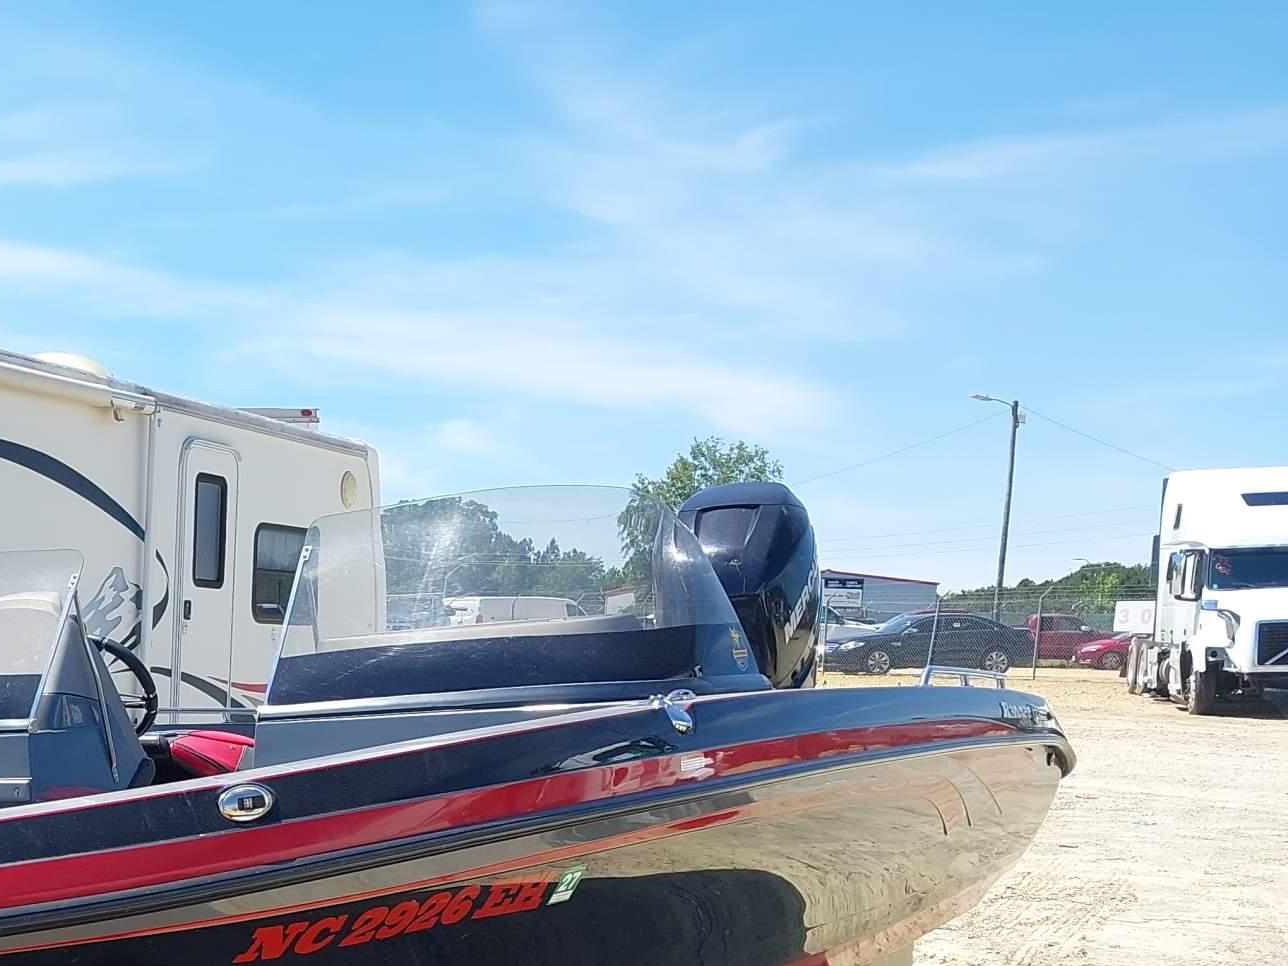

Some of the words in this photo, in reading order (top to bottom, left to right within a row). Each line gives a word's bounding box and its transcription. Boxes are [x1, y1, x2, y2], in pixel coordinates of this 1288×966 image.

[557, 871, 582, 892] 27
[231, 914, 349, 964] NC
[338, 882, 482, 948] 2926
[471, 870, 558, 920] EH
